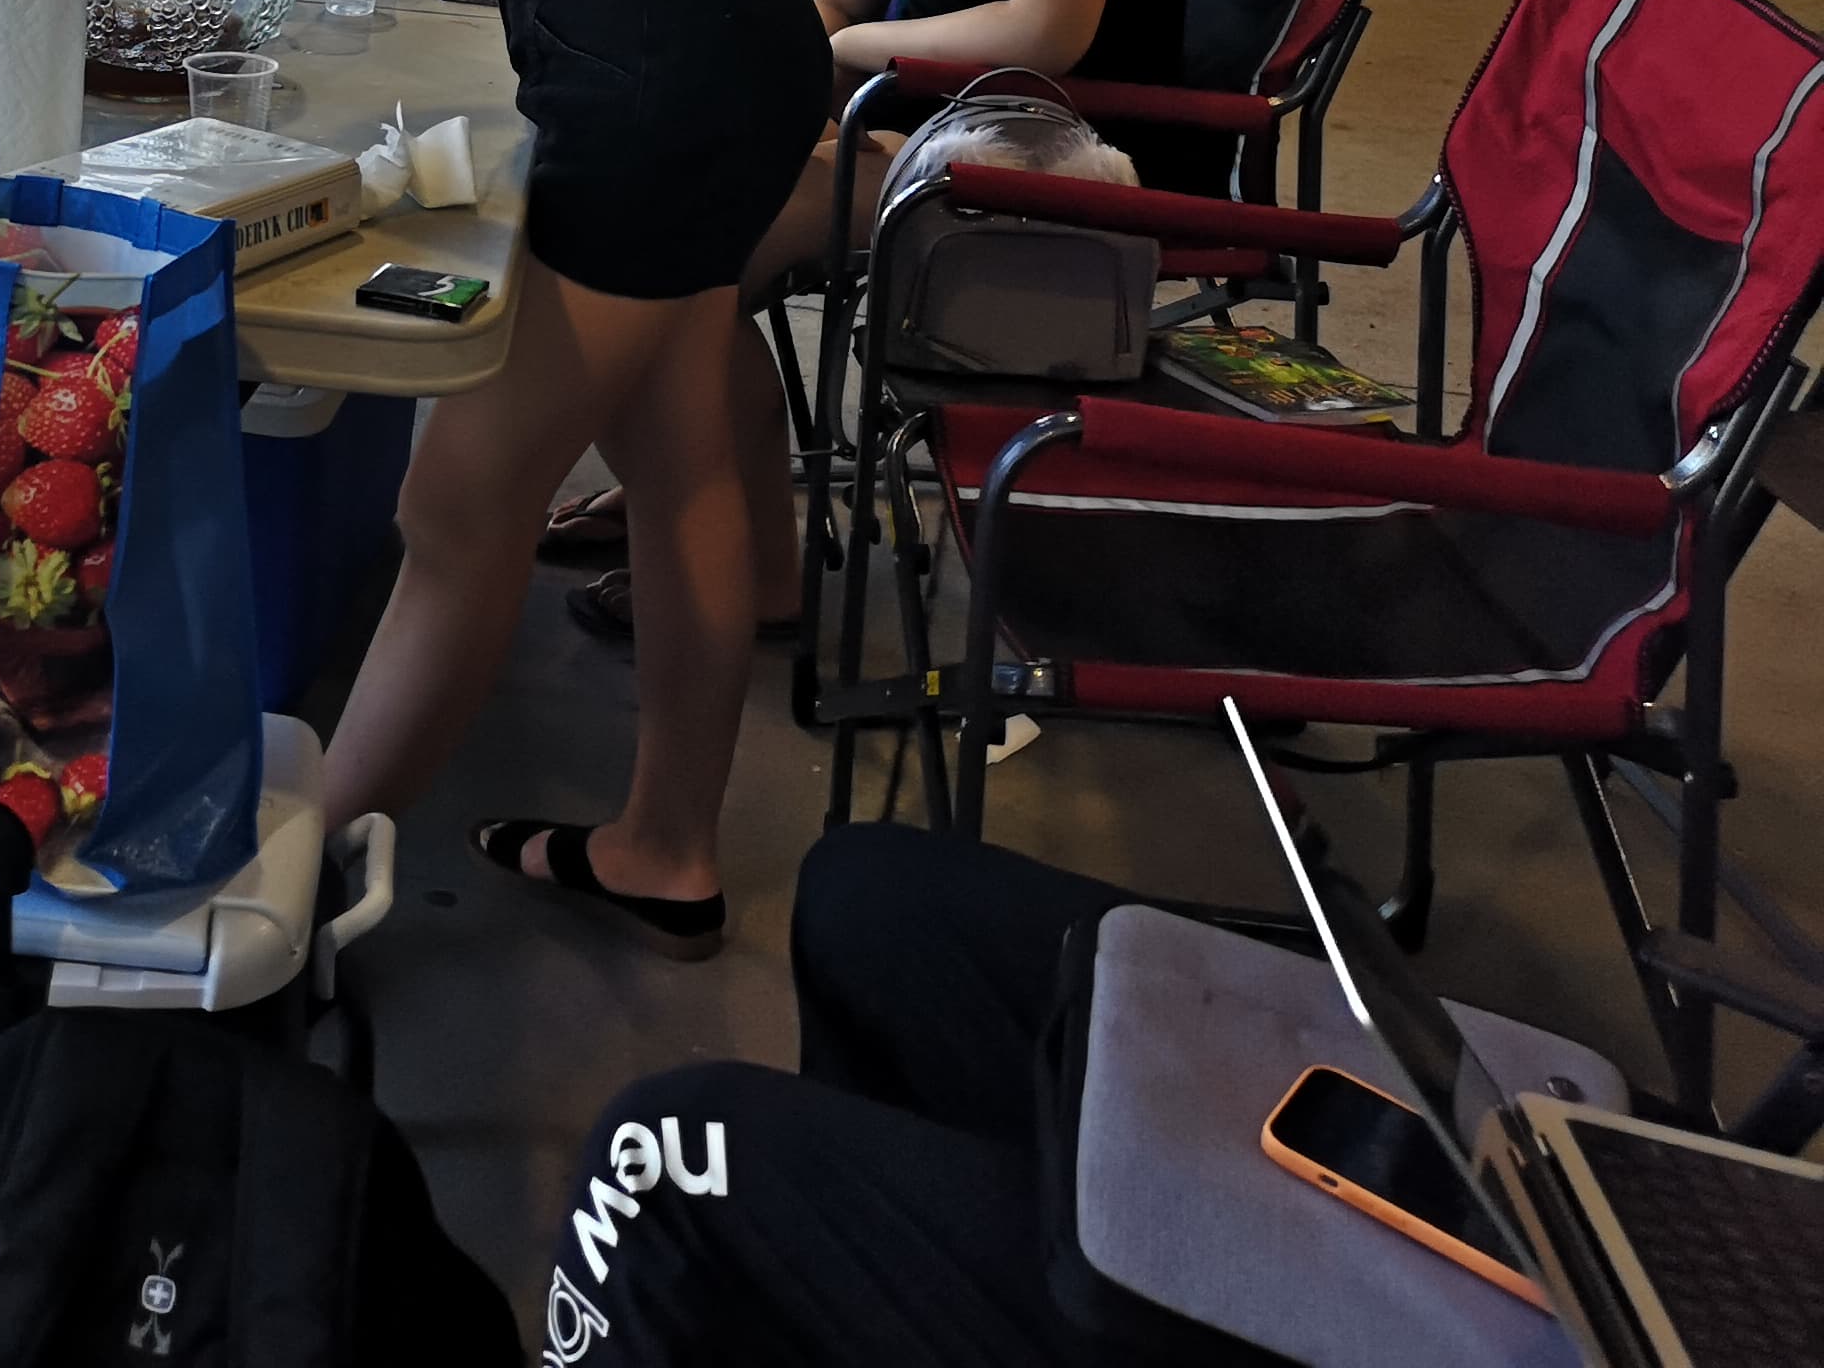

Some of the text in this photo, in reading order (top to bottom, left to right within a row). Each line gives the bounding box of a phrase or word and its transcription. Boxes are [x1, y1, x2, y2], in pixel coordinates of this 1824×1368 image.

[236, 215, 282, 251] DERYK
[542, 1116, 728, 1368] new b
